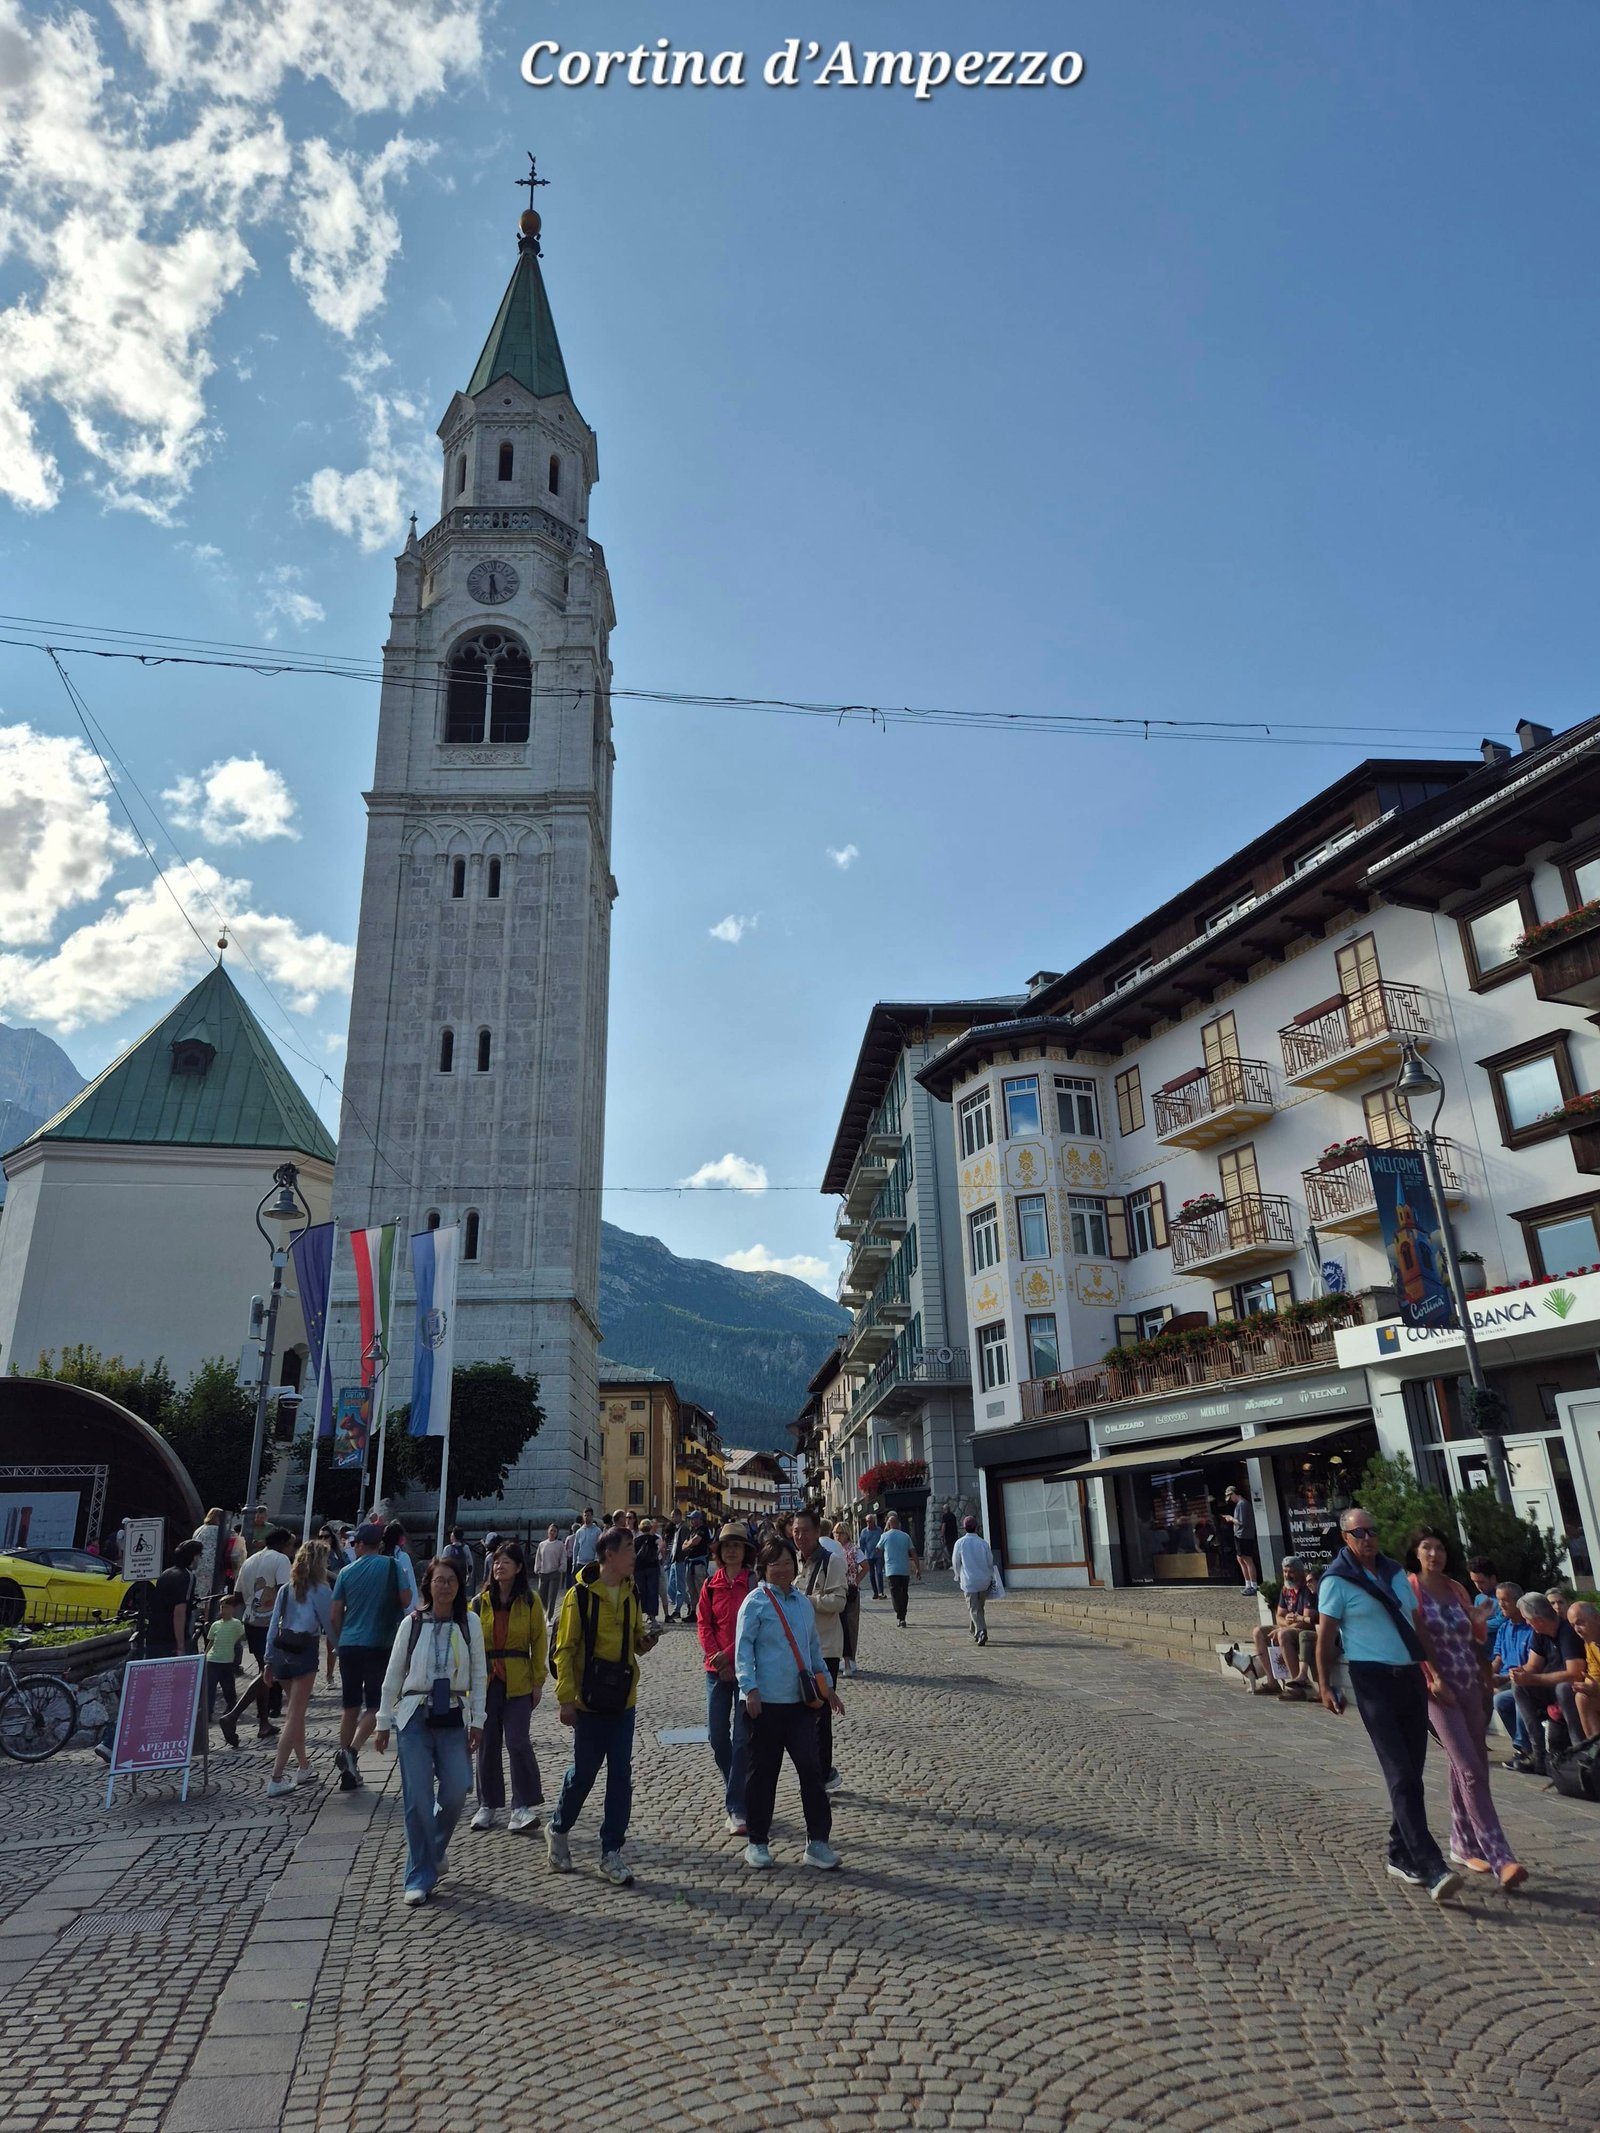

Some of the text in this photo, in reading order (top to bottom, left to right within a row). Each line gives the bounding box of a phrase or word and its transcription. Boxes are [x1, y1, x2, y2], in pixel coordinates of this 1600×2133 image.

[1372, 1156, 1423, 1174] WELCOME
[1410, 1295, 1444, 1320] Cortina
[1310, 1386, 1348, 1399] TECNICA
[1244, 1397, 1284, 1410] NORDICA
[1155, 1411, 1189, 1425] LOWA
[1110, 1420, 1145, 1432] BLIZZARD
[1294, 1550, 1333, 1559] ORTOVOX
[137, 1740, 188, 1753] APERTO
[151, 1748, 186, 1760] OPEN
